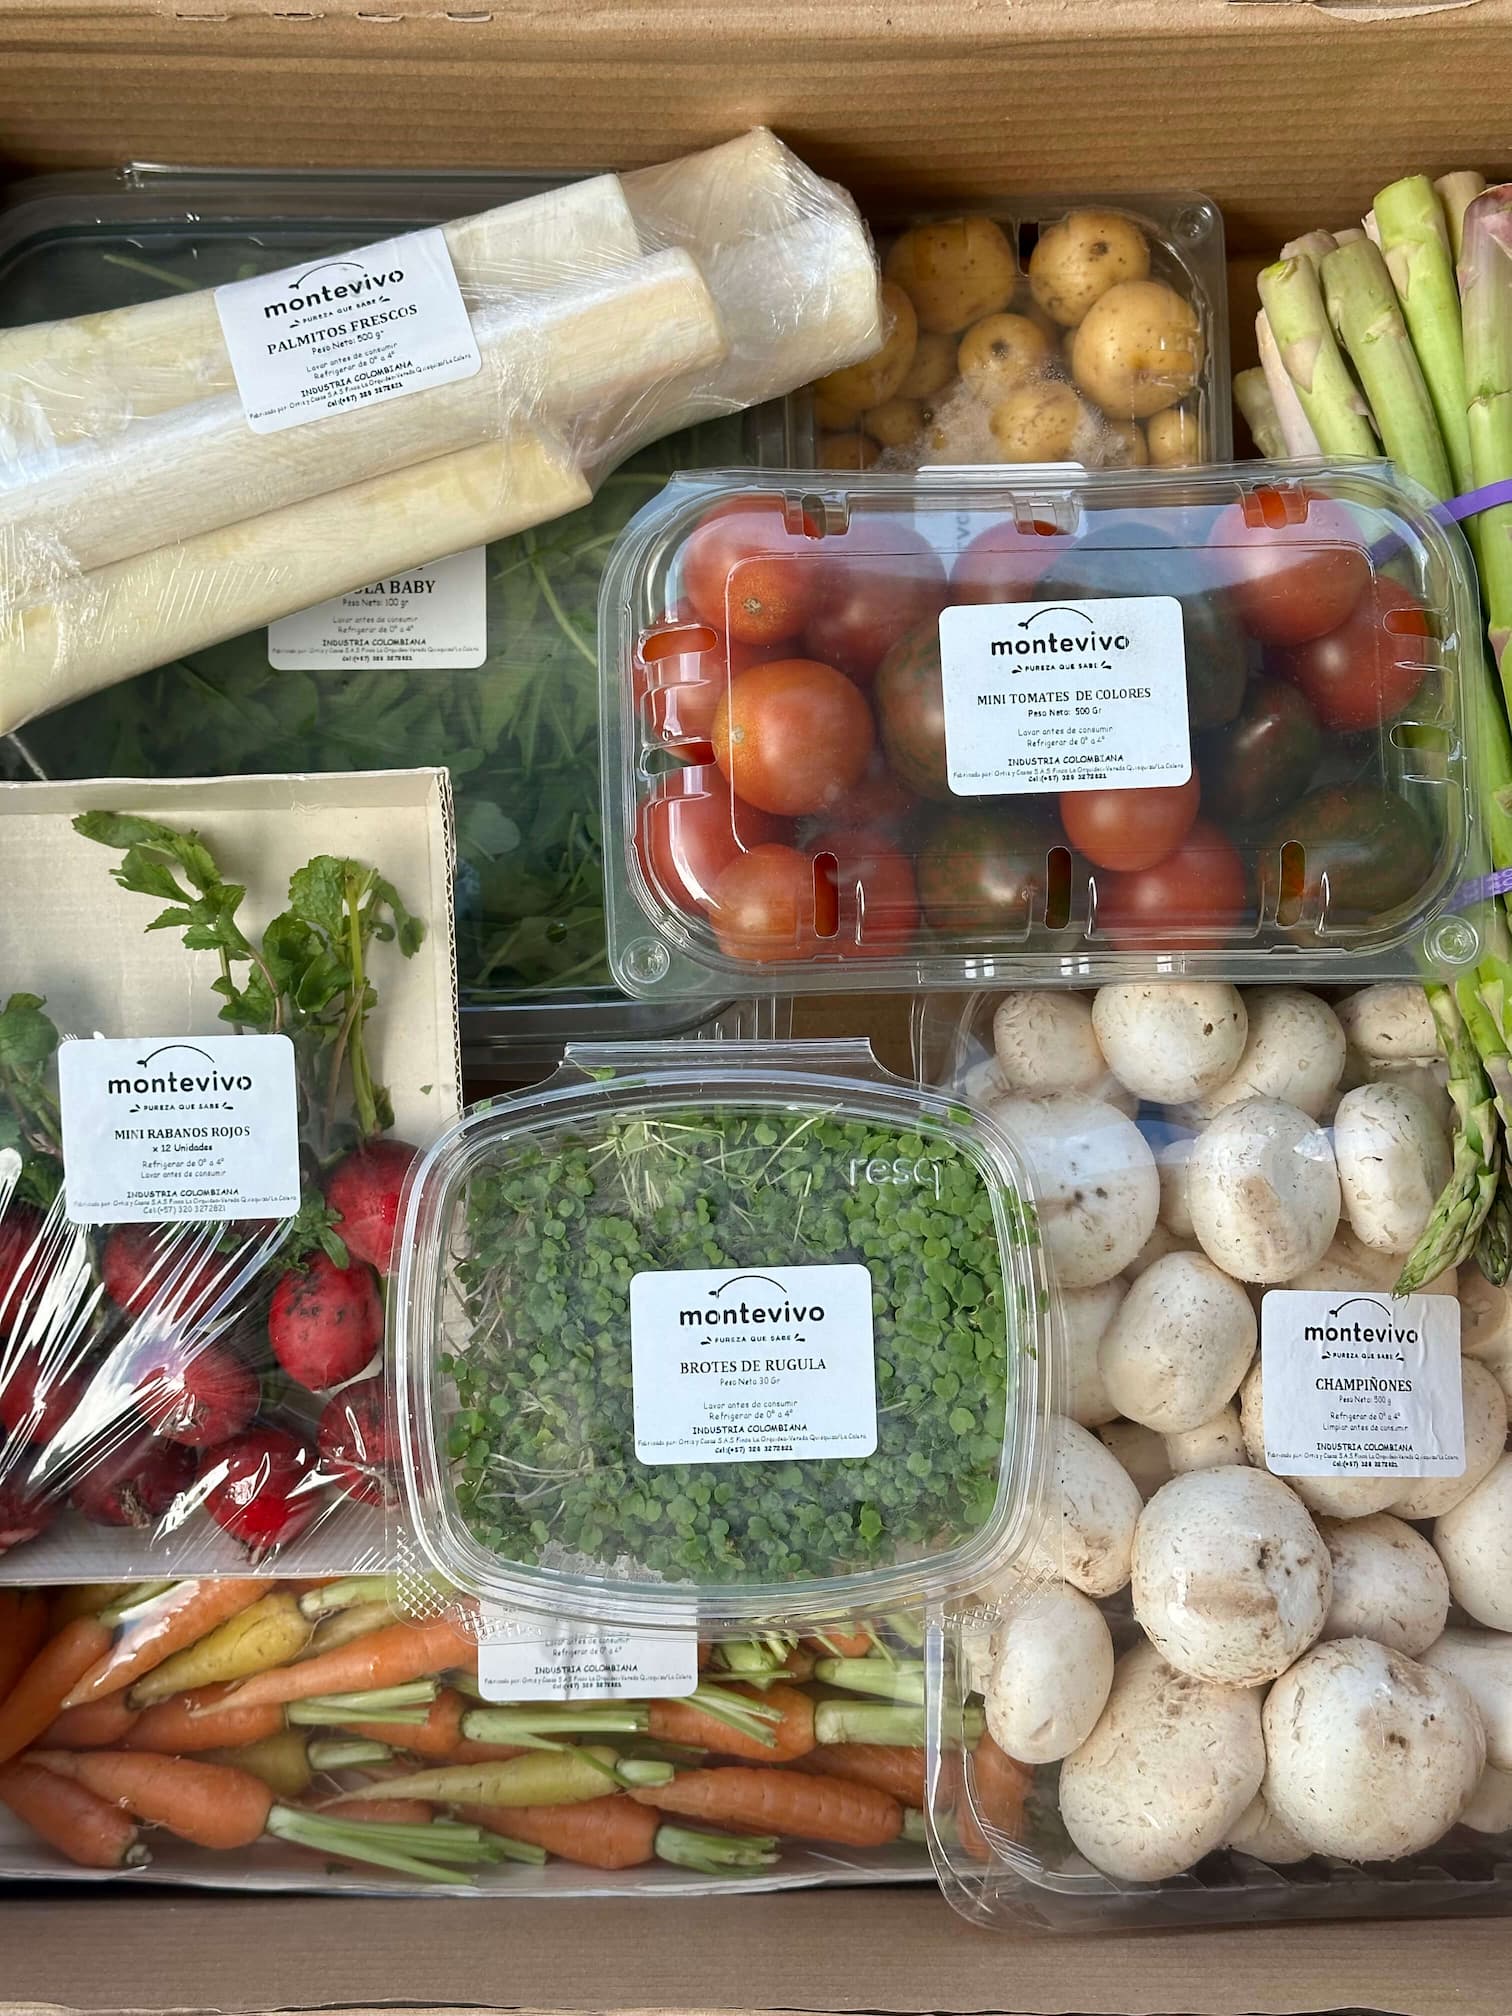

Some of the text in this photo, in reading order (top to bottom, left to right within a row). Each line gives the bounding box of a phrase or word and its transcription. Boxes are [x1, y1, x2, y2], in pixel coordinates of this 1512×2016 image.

[264, 271, 403, 318] montevivo
[303, 312, 333, 323] PUREZA
[357, 299, 375, 308] SABE
[268, 305, 417, 354] PALMITOS FRESCOS
[312, 346, 330, 354] Peso
[357, 332, 373, 342] 500
[306, 363, 327, 372] Lavar
[331, 356, 350, 365] antes
[365, 343, 397, 356] consumir
[314, 365, 355, 379] Refrigerar
[301, 379, 351, 397] INDUSTRIA
[355, 361, 412, 382] COLOMBIANA
[390, 581, 435, 593] BABY
[343, 599, 359, 607] Peso
[991, 631, 1129, 655] montevivo
[977, 687, 1151, 706] MINI TOMATES DE COLORES
[1075, 707, 1090, 715] 500
[1027, 738, 1067, 749] Refrigerar
[1008, 754, 1123, 766] INDUSTRIA COLOMBIANA
[109, 1071, 251, 1094] montevivo
[115, 1126, 250, 1140] MINI RABANOS ROJOS
[174, 1144, 212, 1152] Unidades
[142, 1160, 184, 1170] Refrigerar
[187, 1159, 196, 1167] de
[849, 1157, 941, 1201] resq
[127, 1188, 239, 1198] INDUSTRIA COLOMBIANA
[680, 1301, 824, 1325] montevivo
[1305, 1322, 1418, 1343] montevivo
[680, 1357, 826, 1374] BROTES DE RUGULA
[720, 1378, 737, 1386] Peso
[1315, 1376, 1412, 1392] CHAMPIÑONES
[703, 1402, 726, 1410] Lavar
[1374, 1396, 1386, 1404] 500
[709, 1412, 751, 1422] Refrigerar
[755, 1411, 764, 1419] de
[1330, 1412, 1367, 1422] Refrigerar
[692, 1423, 807, 1435] INDUSTRIA COLOMBIANA
[1323, 1424, 1348, 1432] Limpiar
[1317, 1443, 1362, 1451] INDUSTRIA
[535, 1666, 580, 1674] INDUSTRIA
